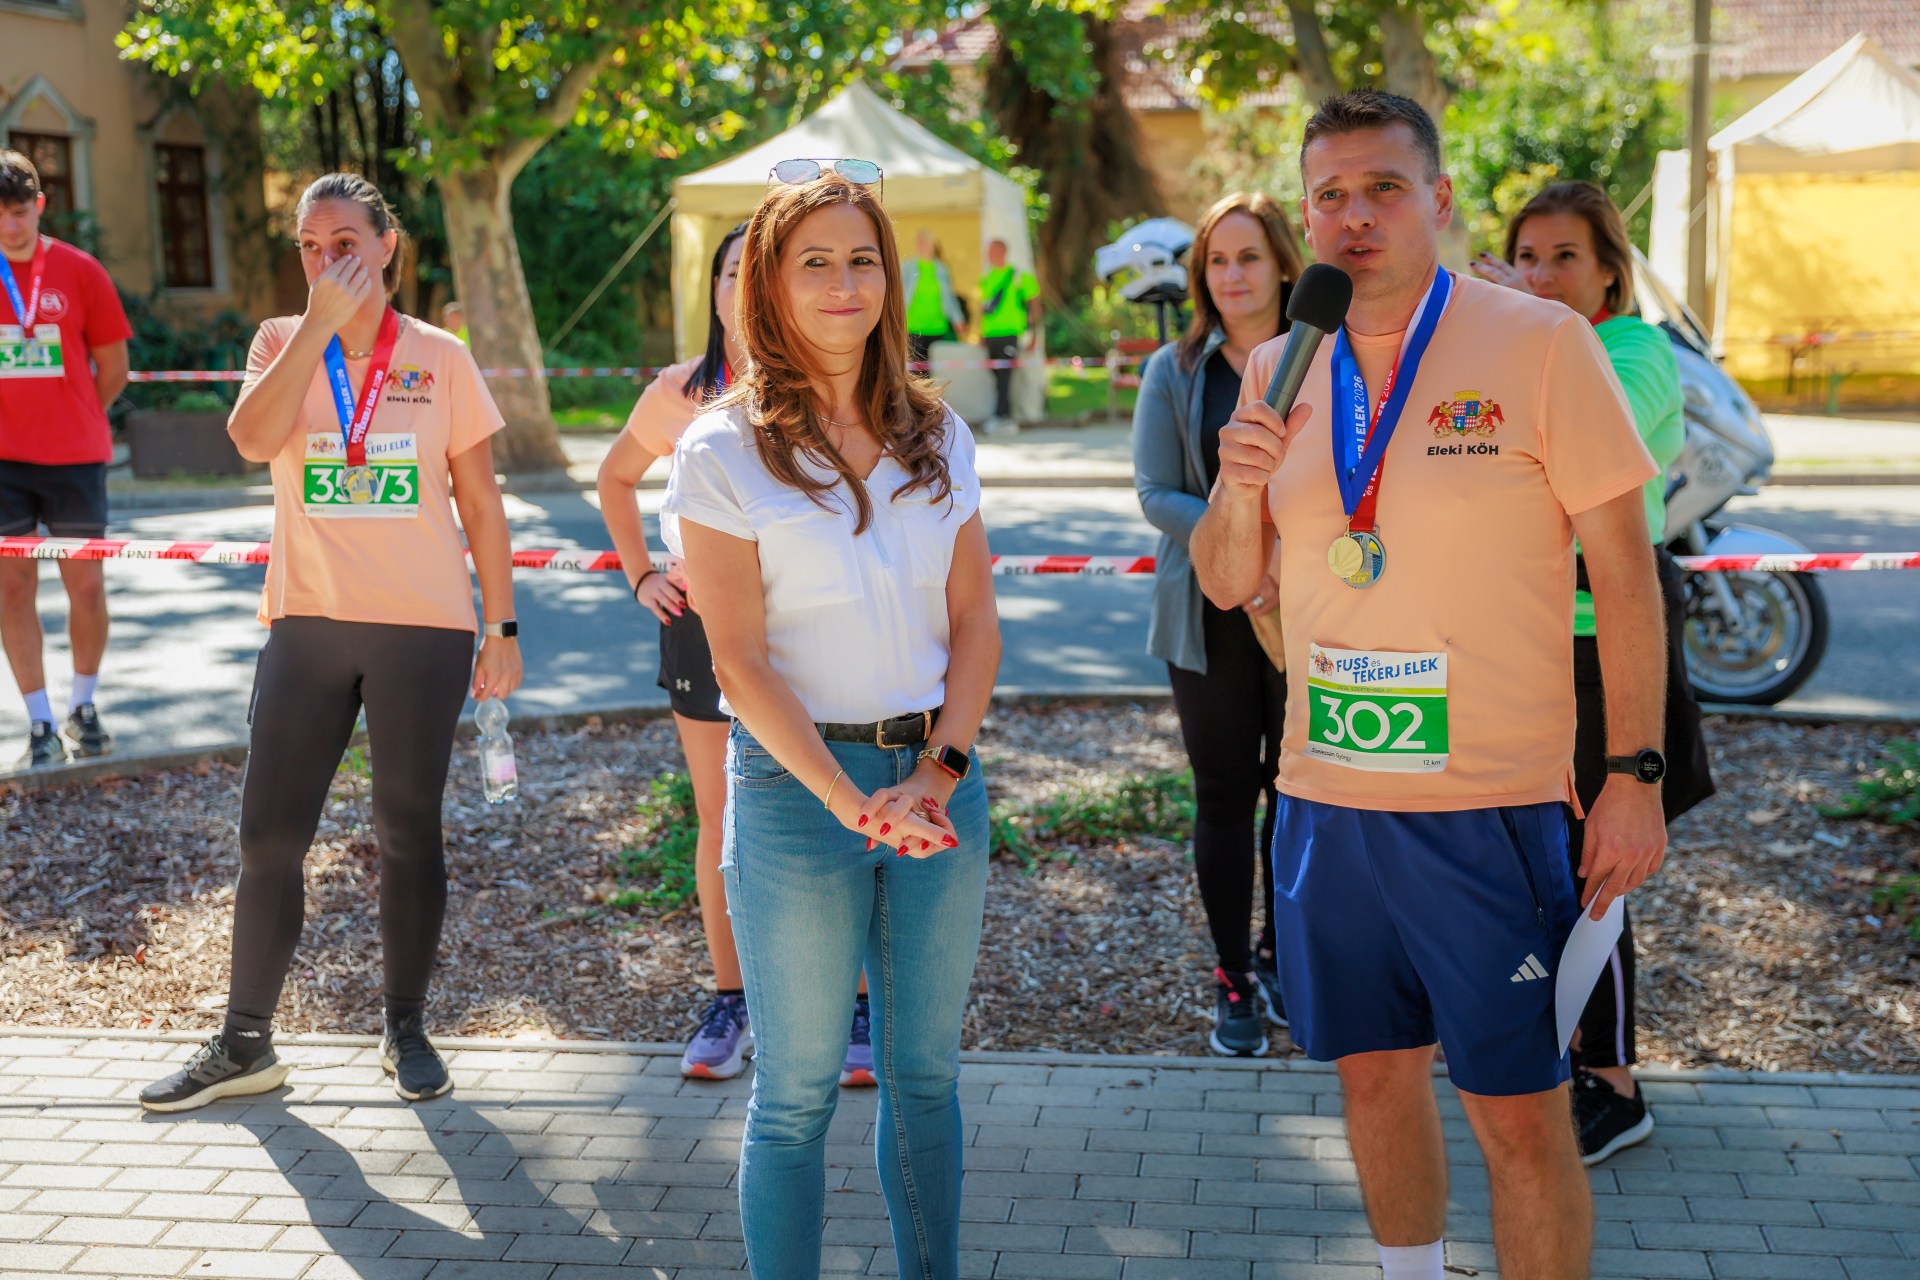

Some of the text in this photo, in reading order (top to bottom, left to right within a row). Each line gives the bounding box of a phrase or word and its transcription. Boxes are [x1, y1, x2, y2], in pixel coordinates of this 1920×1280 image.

[386, 396, 410, 404] Eleki
[1353, 375, 1365, 403] 2026
[1354, 404, 1366, 435] ELEK
[365, 443, 387, 455] KERJ
[390, 439, 411, 451] ELEK
[1427, 442, 1499, 456] Eleki KÖH
[310, 468, 413, 503] 35/3
[1336, 657, 1381, 672] FUSS és
[1352, 657, 1438, 683] TEKERJ ELEK
[1320, 695, 1426, 750] 302
